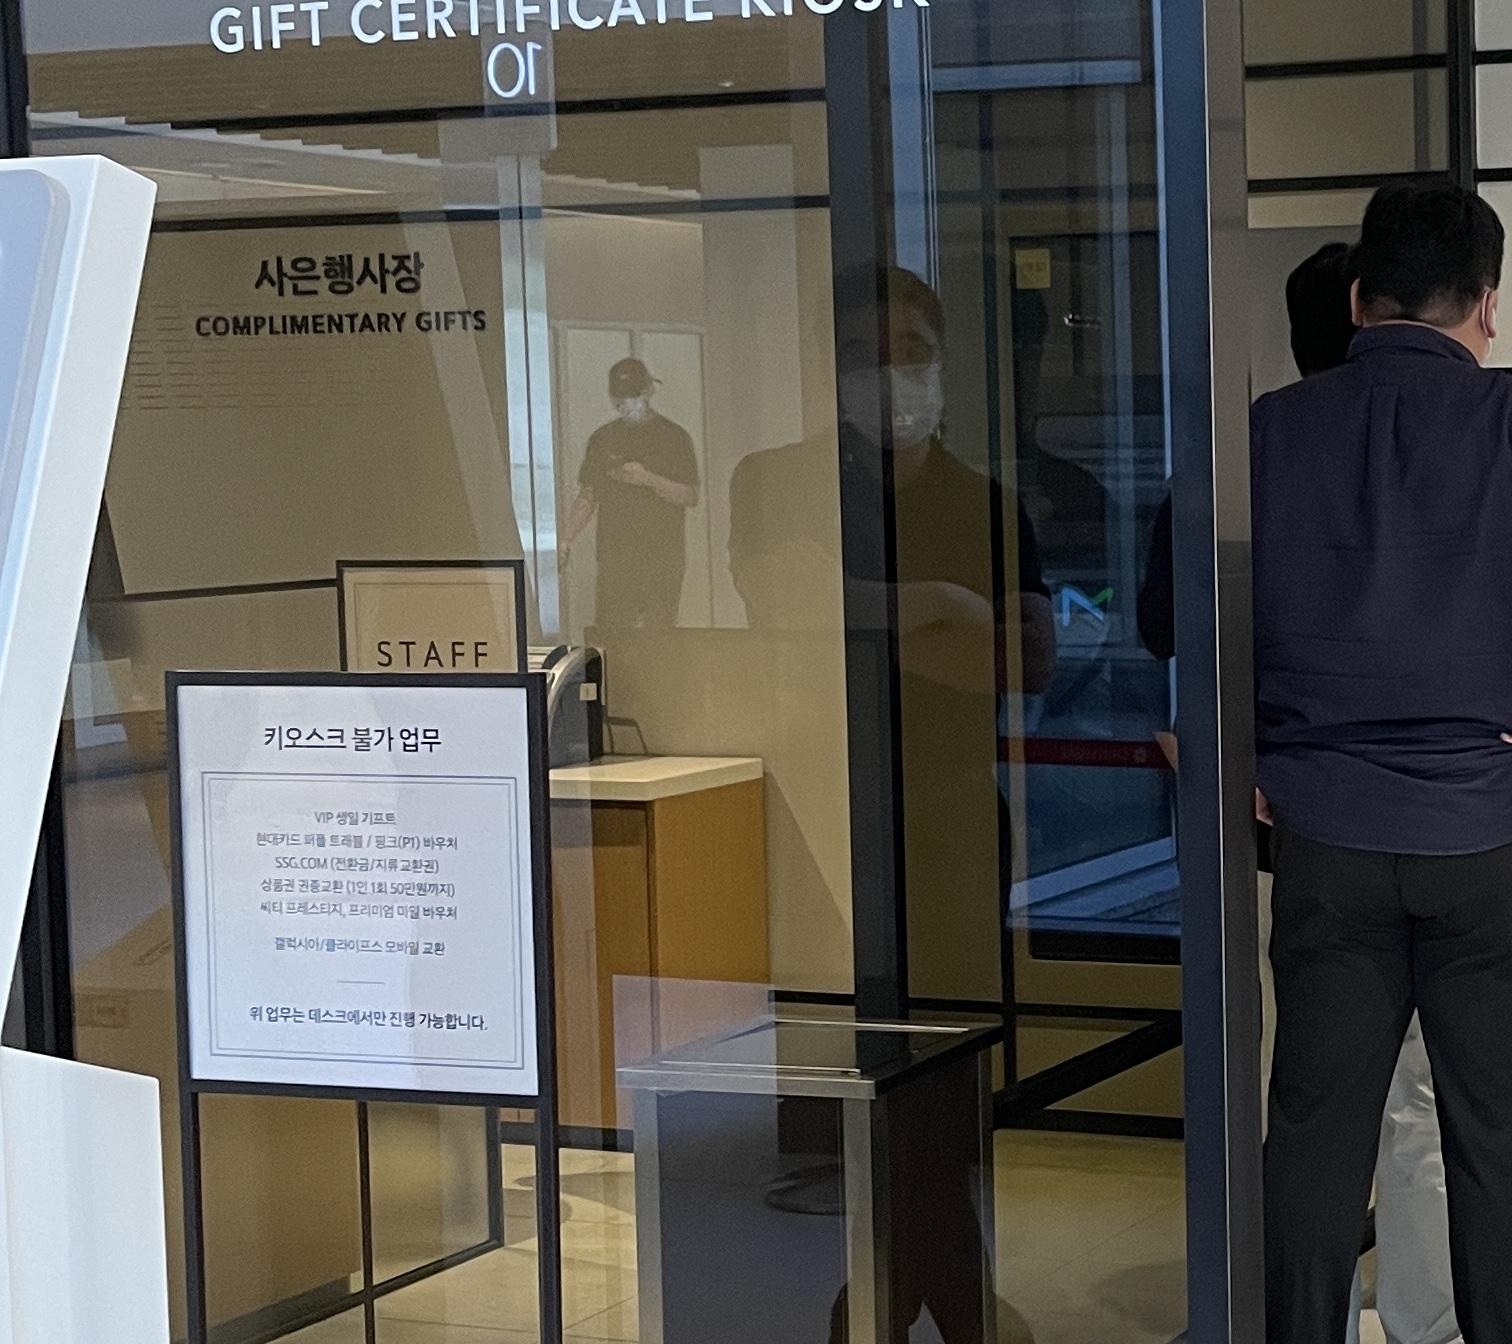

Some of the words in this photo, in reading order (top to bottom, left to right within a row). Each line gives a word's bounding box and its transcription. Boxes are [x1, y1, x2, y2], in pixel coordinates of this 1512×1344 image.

[210, 1, 331, 55] GIFT
[254, 252, 424, 297] 사은행사장
[195, 308, 407, 338] COMPLIMENTARY
[416, 308, 487, 334] GIFTS
[376, 640, 489, 669] STAFF
[264, 726, 346, 750] 키오스크
[352, 727, 394, 752] 불가
[400, 727, 441, 752] 업무
[315, 812, 334, 824] VIP
[361, 812, 396, 825] 기프트
[275, 857, 327, 869] SSG.COM
[250, 1007, 263, 1022] 위
[266, 1007, 305, 1023] 업무는
[308, 1008, 387, 1026] 데스크에서만
[390, 1011, 416, 1027] 진행
[419, 1013, 488, 1031] 가능합니다.
